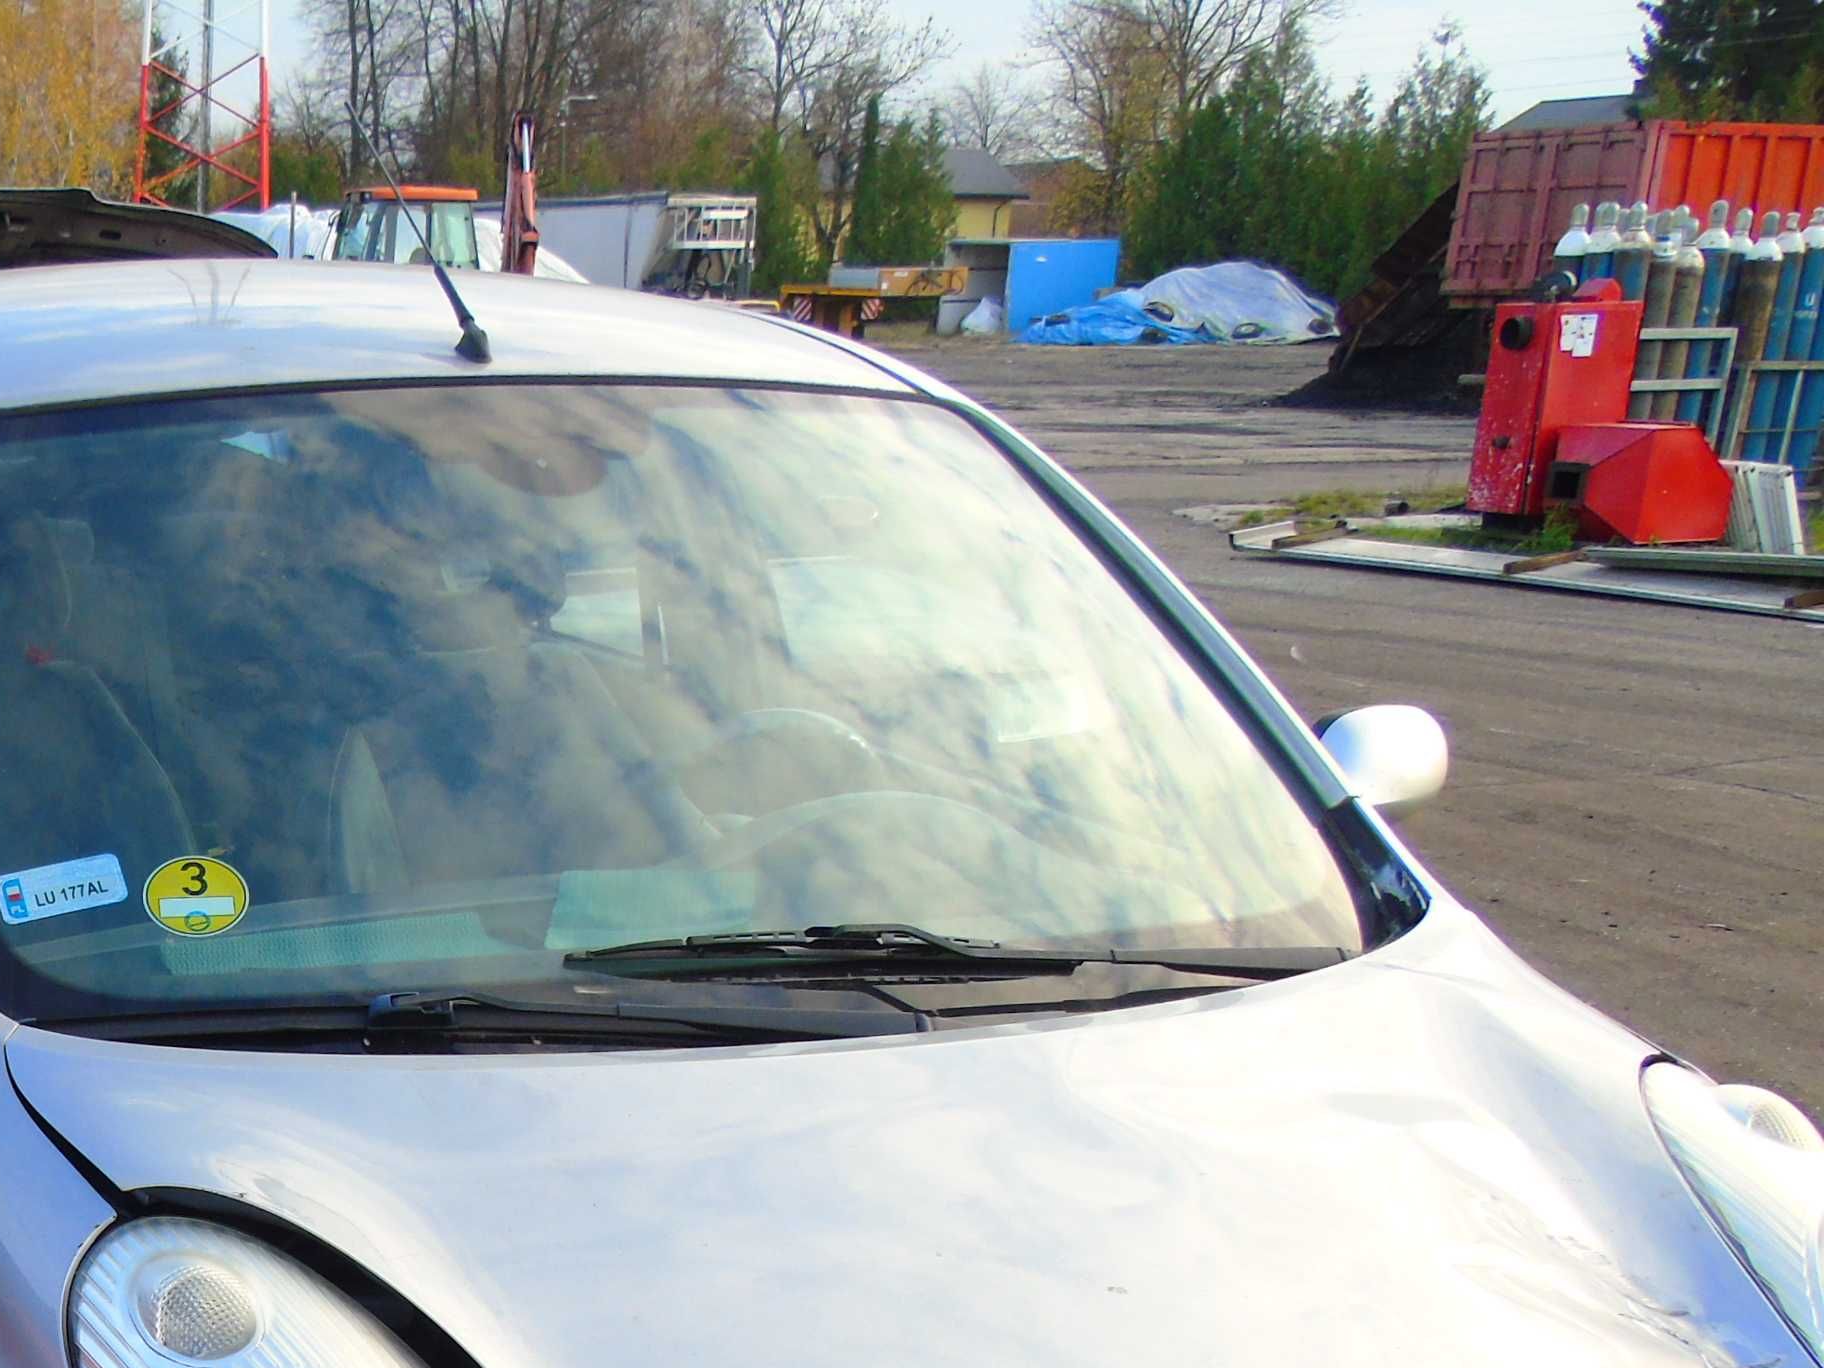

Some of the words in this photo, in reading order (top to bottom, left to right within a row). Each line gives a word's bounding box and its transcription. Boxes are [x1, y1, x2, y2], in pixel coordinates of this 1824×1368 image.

[34, 891, 57, 908] LU
[60, 880, 109, 903] 177AL
[180, 861, 208, 897] 3
